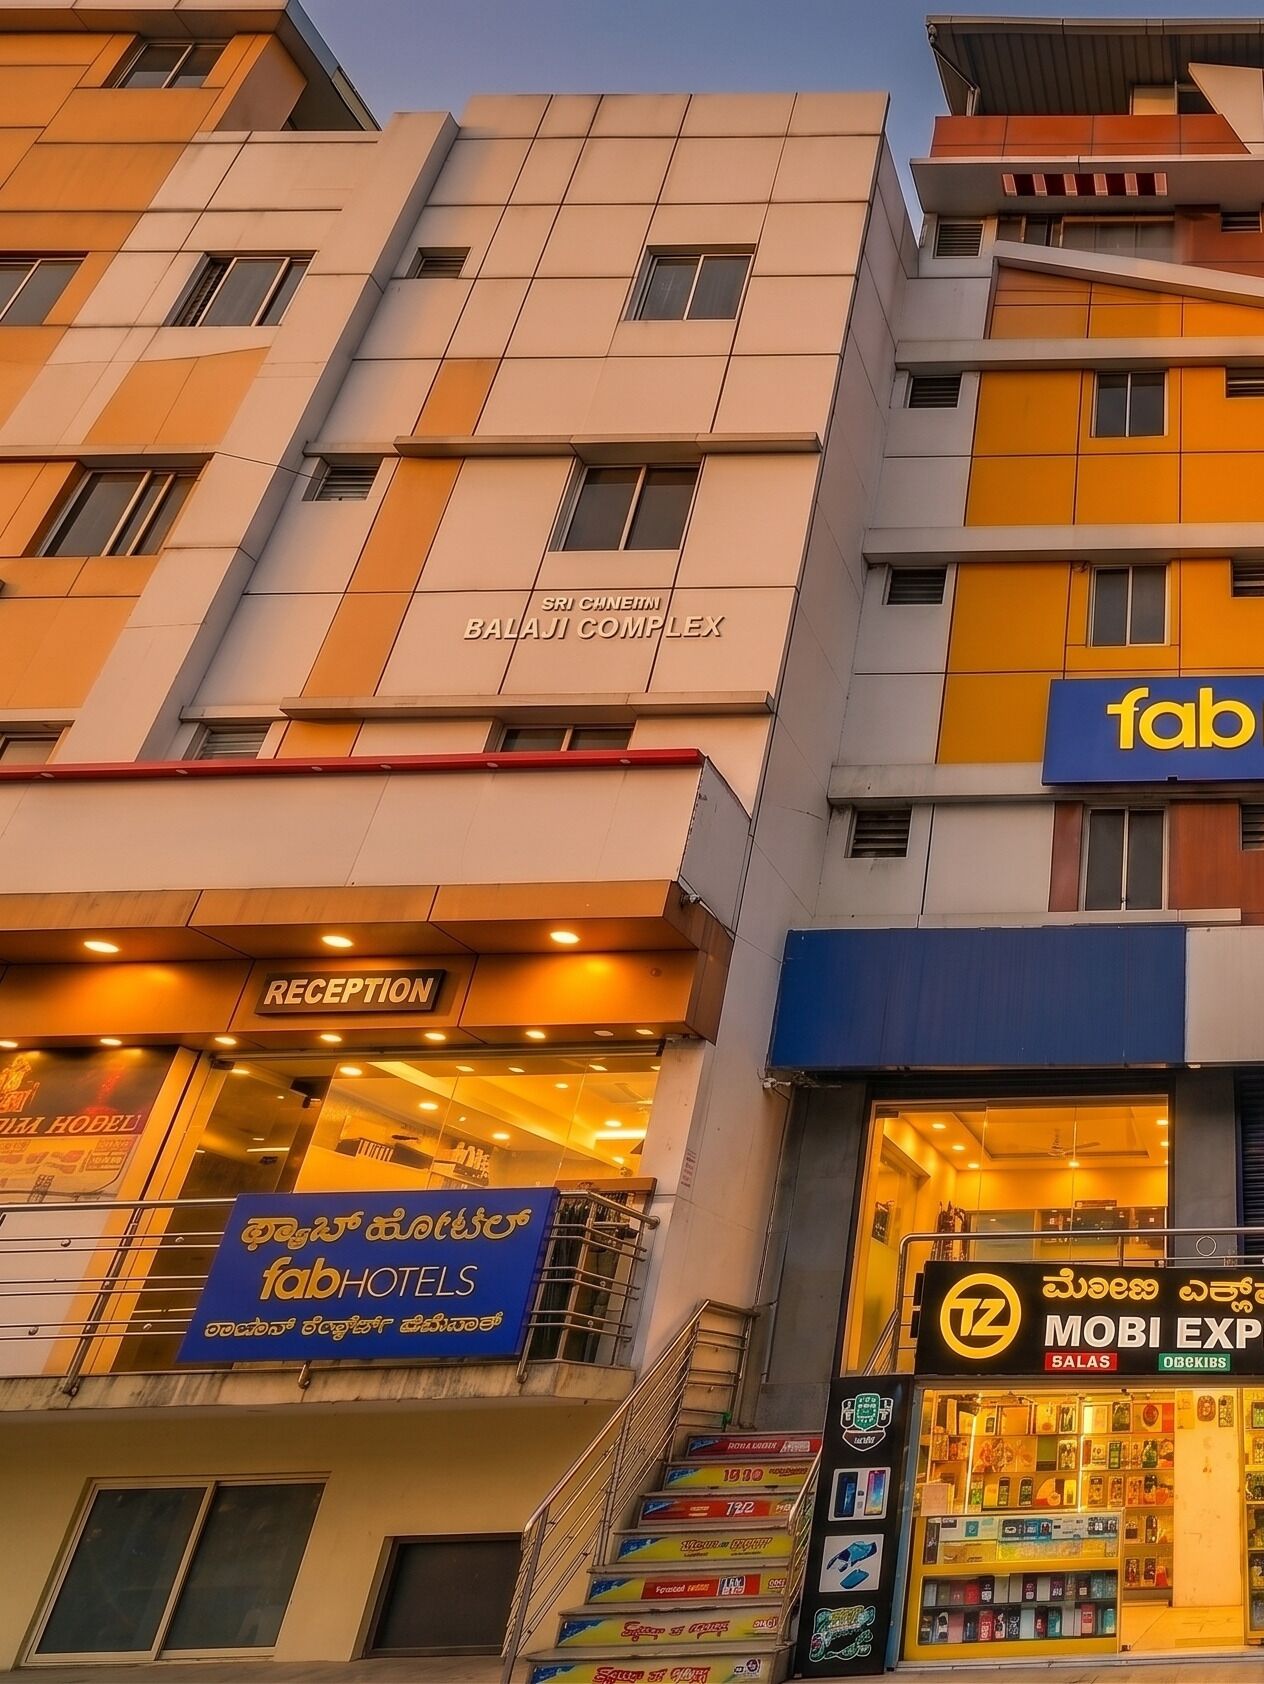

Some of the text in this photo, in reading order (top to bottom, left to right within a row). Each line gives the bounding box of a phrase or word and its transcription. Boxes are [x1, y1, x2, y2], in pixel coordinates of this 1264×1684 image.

[541, 597, 574, 611] SRI
[463, 615, 726, 640] BALAJI COMPLEX
[263, 976, 435, 1006] RECEPTION
[1044, 1315, 1160, 1348] MOBI
